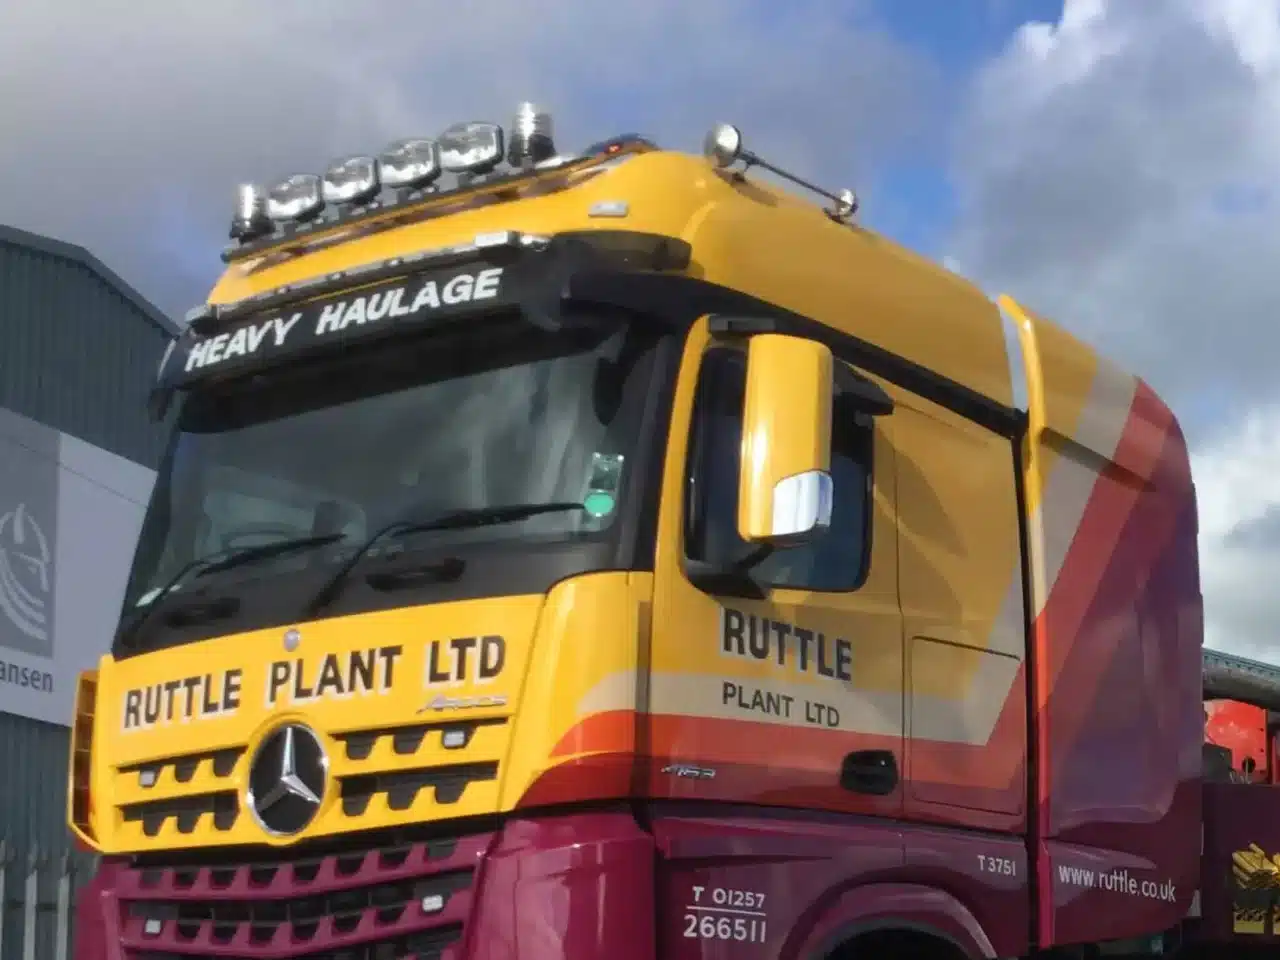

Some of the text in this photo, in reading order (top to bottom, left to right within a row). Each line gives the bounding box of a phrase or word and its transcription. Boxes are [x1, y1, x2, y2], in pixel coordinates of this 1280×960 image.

[184, 267, 504, 373] HEAVY HAULAGE
[723, 607, 852, 681] RUTTLE
[122, 635, 506, 731] RUTTLE PLANT LTD
[722, 681, 840, 727] PLANT LTD
[692, 885, 705, 902] T
[1058, 864, 1176, 903] www.ruttle.co.uk
[683, 914, 766, 943] 266511
